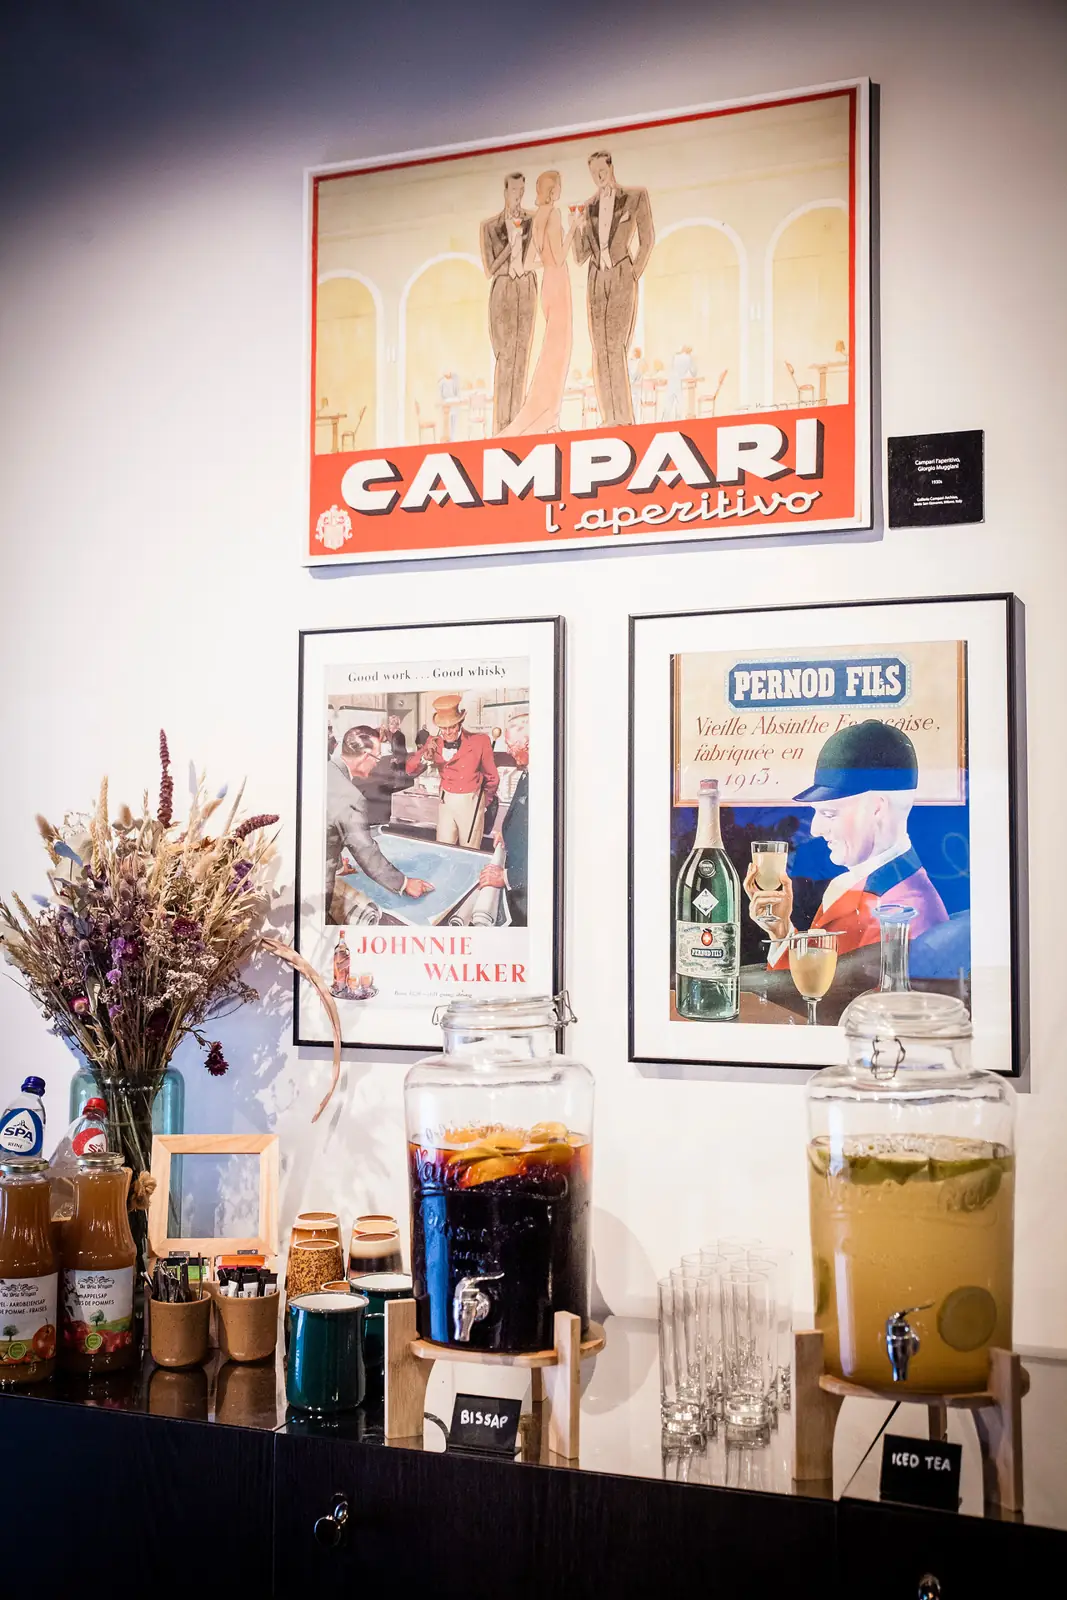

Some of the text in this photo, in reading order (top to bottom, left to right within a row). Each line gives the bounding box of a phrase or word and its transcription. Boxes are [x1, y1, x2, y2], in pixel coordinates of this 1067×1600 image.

[341, 418, 824, 515] CAMPARI
[348, 671, 379, 682] Good
[383, 669, 411, 680] work
[432, 666, 464, 678] Good
[468, 664, 506, 679] whisky
[734, 664, 902, 701] PERNOD FILS
[697, 716, 747, 736] Vieille
[751, 714, 830, 736] Absinthe
[693, 743, 804, 767] fabriquée en
[357, 936, 473, 956] JOHNNIE
[424, 963, 527, 983] WALKER
[4, 1127, 33, 1143] SPA
[460, 1409, 509, 1429] BISSAP
[891, 1452, 951, 1472] ICED TEA
